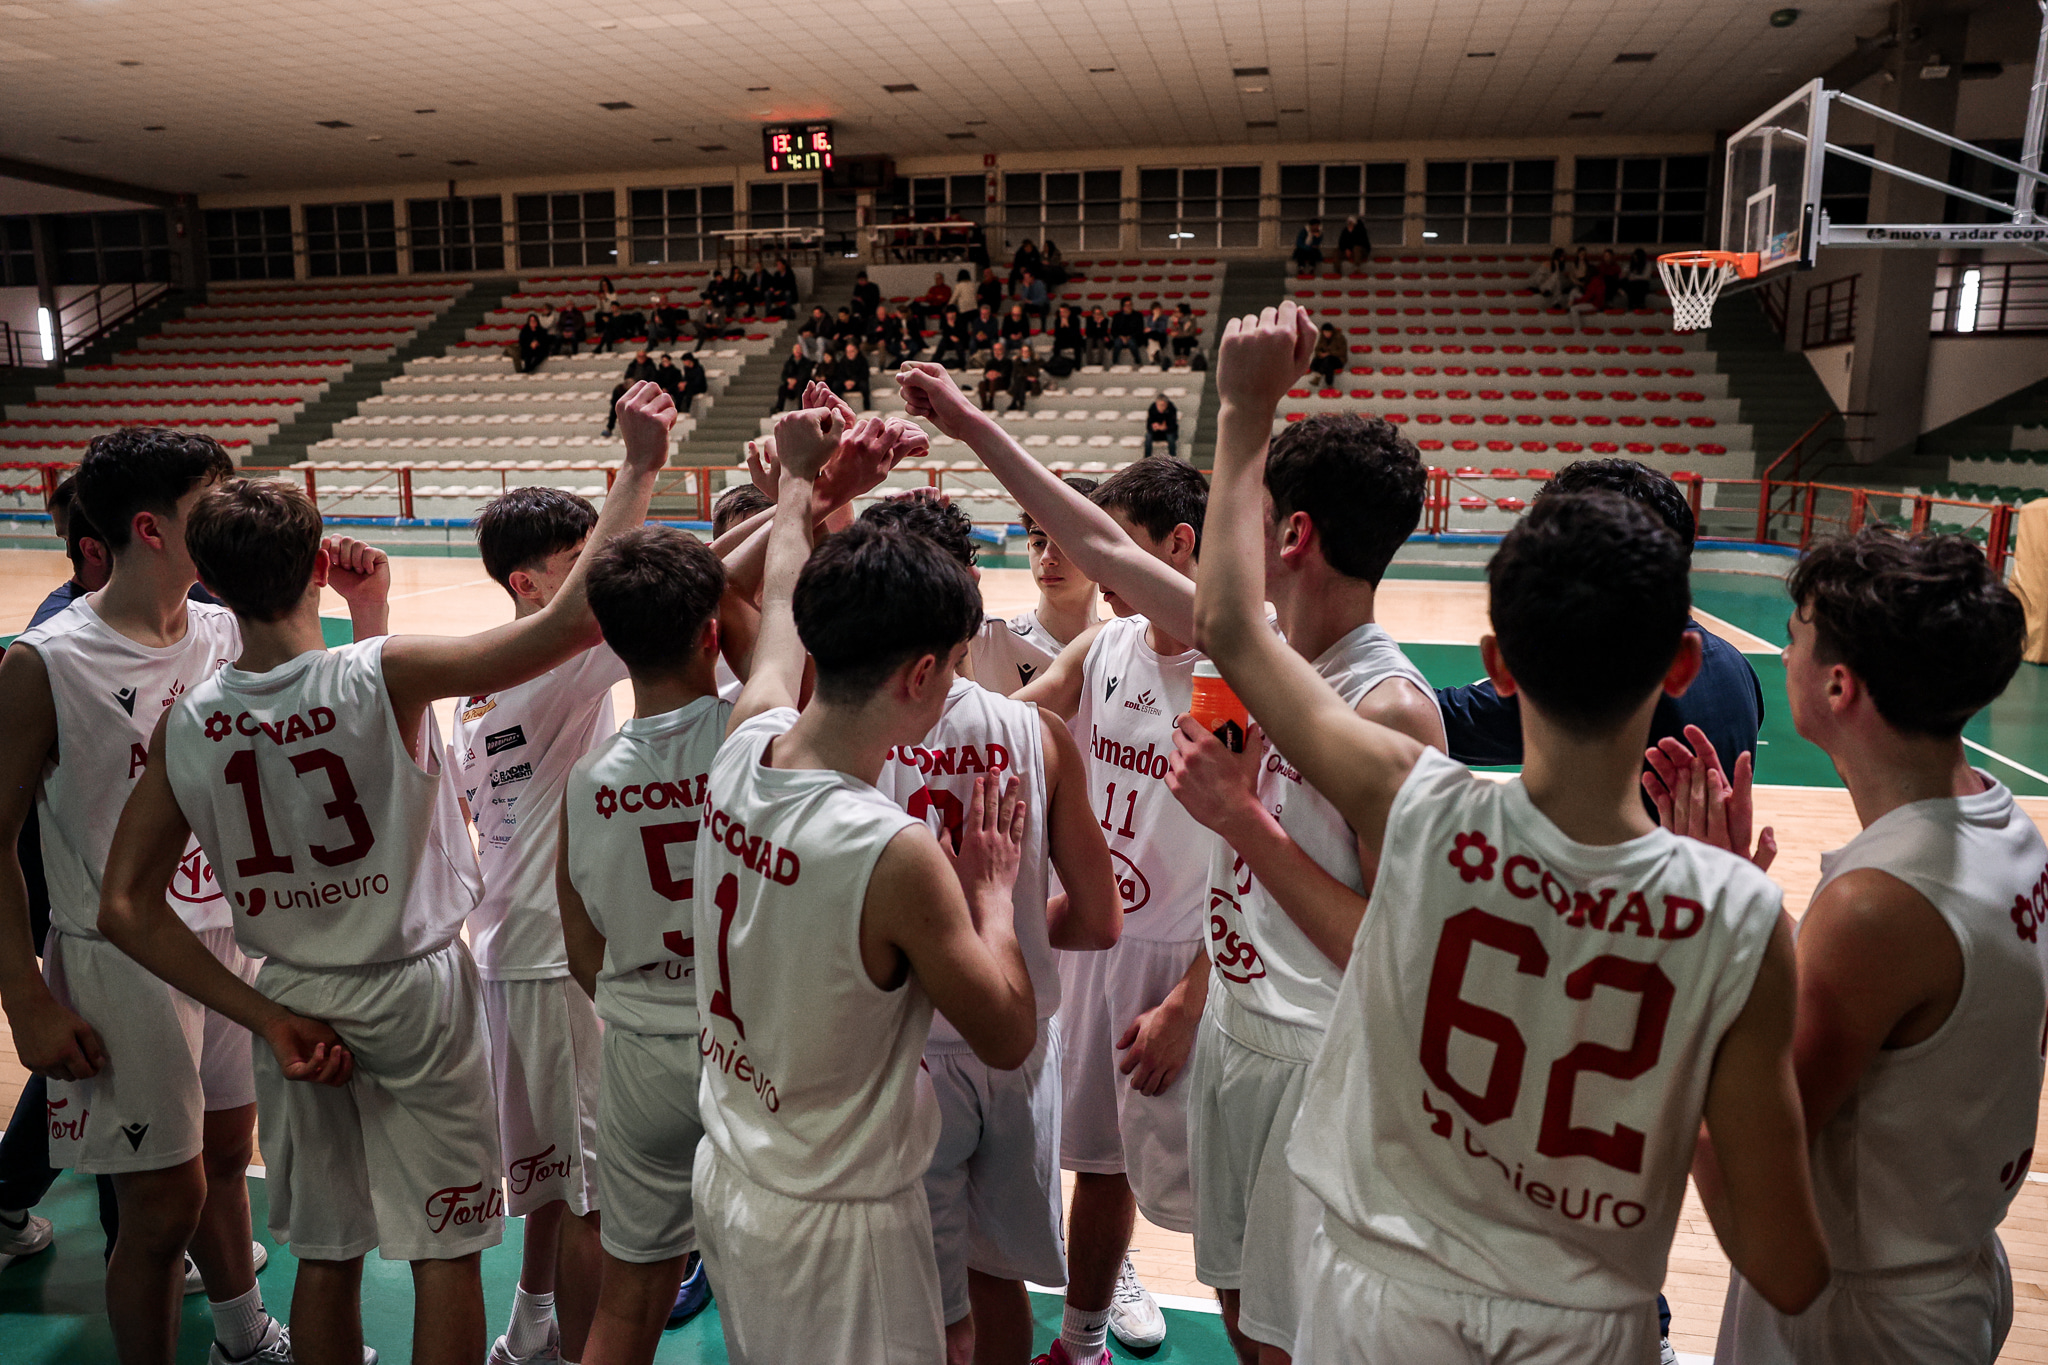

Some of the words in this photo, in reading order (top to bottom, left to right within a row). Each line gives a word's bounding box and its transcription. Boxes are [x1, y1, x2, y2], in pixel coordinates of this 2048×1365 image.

[771, 156, 779, 170] 1
[787, 152, 820, 170] 4:17
[825, 153, 832, 168] 1
[1889, 229, 1942, 240] nuova
[1949, 229, 1998, 240] radar
[1124, 700, 1141, 711] EDIL
[1089, 723, 1172, 780] Amado
[223, 747, 376, 878] 13
[1100, 781, 1139, 840] 11
[711, 809, 801, 887] CONAD
[273, 873, 389, 910] unieuro
[1502, 854, 1705, 941] CONAD
[709, 871, 747, 1043] 1
[700, 1026, 780, 1114] unieuro
[1418, 905, 1677, 1175] 62
